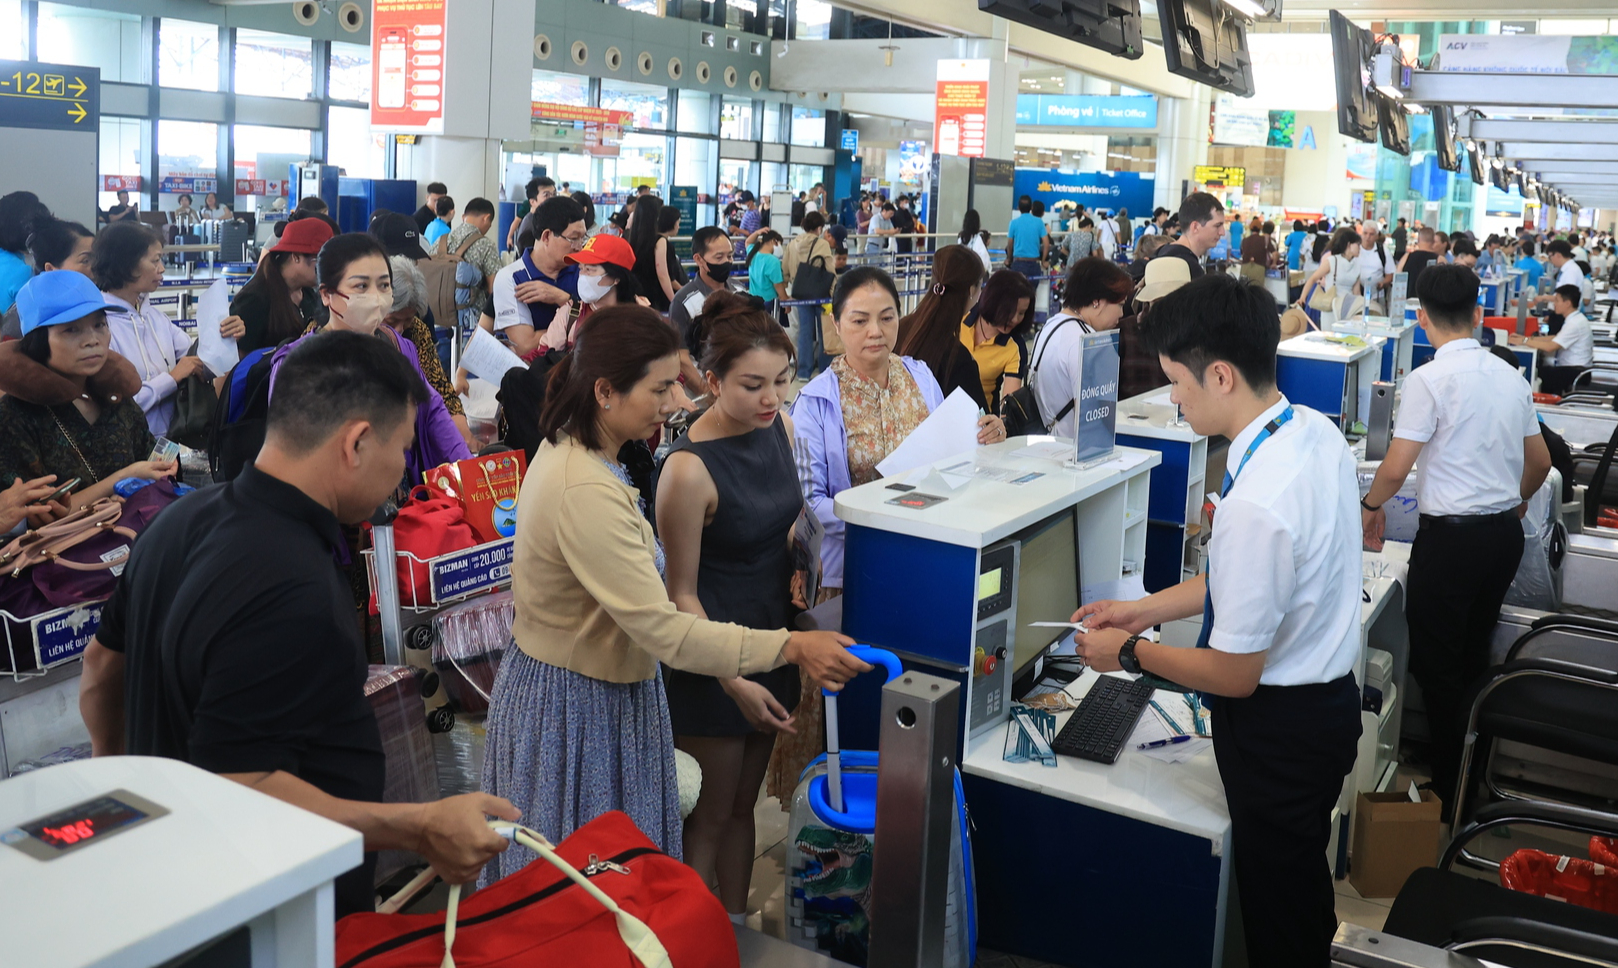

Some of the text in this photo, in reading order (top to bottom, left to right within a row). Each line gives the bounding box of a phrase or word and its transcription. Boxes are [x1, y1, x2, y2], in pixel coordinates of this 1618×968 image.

[1446, 42, 1468, 50] ACV
[1048, 105, 1147, 119] Phòng vé Ticket Office
[1298, 125, 1317, 150] A
[1051, 183, 1109, 195] Vietnam Airlines
[1082, 386, 1100, 401] ĐÓNG
[1086, 406, 1109, 422] CLOSED
[440, 548, 506, 574] BIZMAN 20.000
[441, 584, 453, 594] LIÊN
[453, 581, 460, 591] HỆ
[461, 577, 477, 588] QUẢNG
[478, 573, 487, 583] CÁO
[48, 644, 64, 658] LIÊN
[65, 640, 74, 651] HỆ
